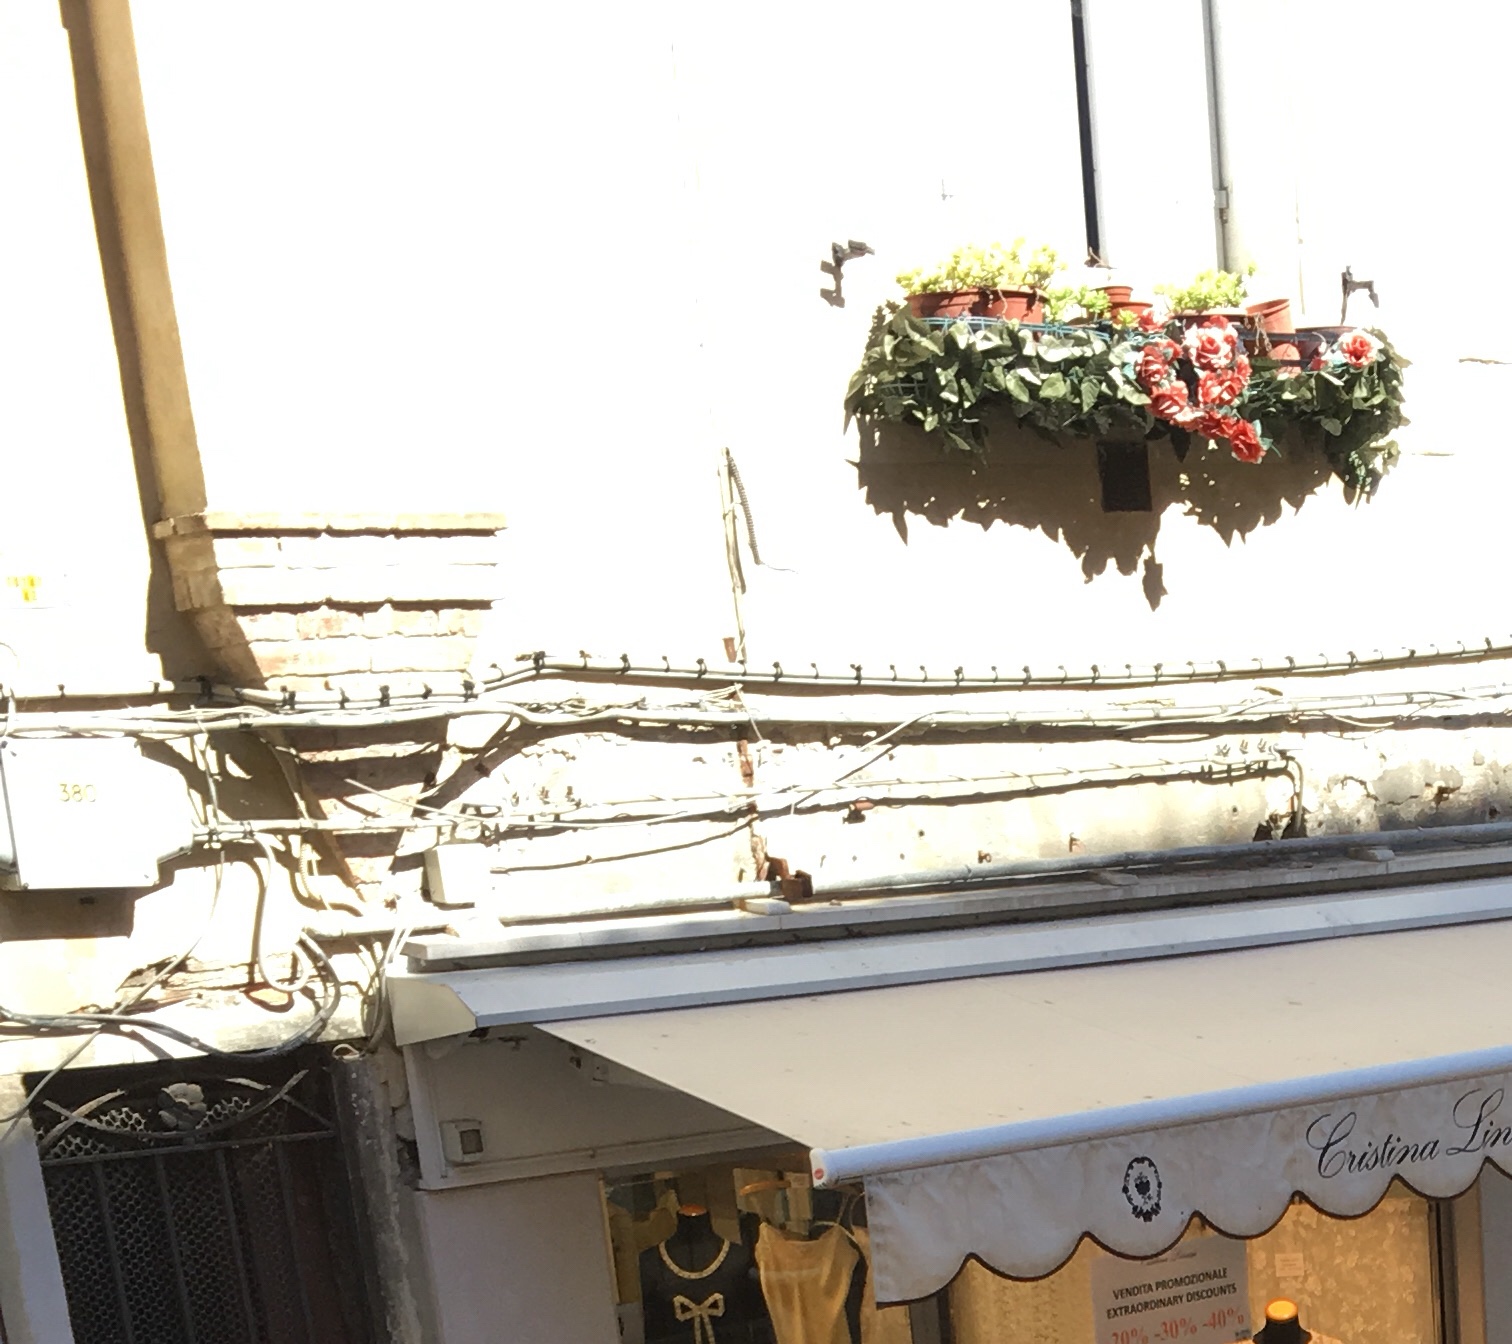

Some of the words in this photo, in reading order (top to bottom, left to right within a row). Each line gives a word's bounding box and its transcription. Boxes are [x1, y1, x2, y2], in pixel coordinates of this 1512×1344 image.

[58, 783, 97, 802] 380
[1305, 1111, 1440, 1179] Cristina
[1112, 1283, 1154, 1300] VENDITA
[1155, 1267, 1228, 1291] PROMOZIONALE
[1106, 1296, 1183, 1320] EXTRAORDINARY
[1186, 1282, 1238, 1303] DISCOUNTS
[1153, 1317, 1198, 1341] -30%
[1202, 1307, 1245, 1330] -40%
